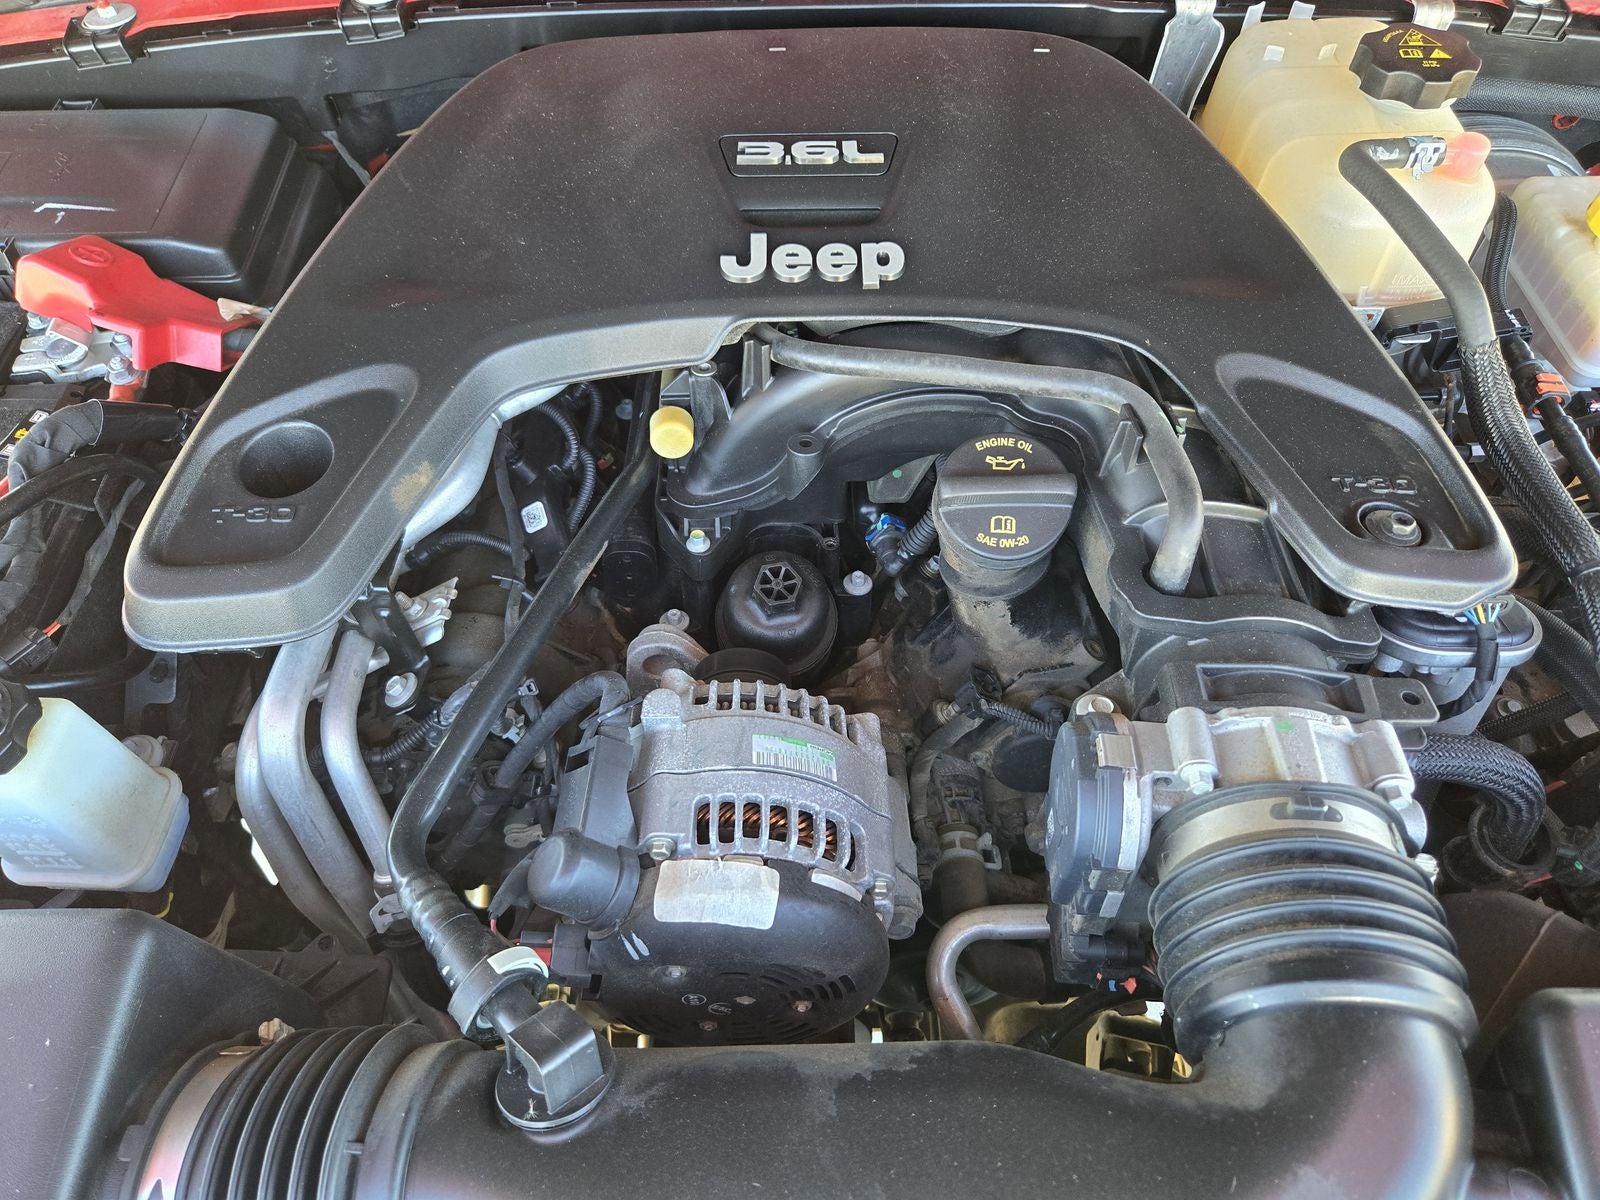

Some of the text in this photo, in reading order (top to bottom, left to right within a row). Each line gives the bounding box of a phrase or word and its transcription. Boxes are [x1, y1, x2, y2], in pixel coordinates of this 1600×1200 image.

[736, 140, 885, 165] 3.6L
[719, 232, 905, 290] Jeep
[975, 437, 1033, 454] ENGINE OIL
[211, 506, 296, 523] T-30
[976, 532, 1030, 548] SAE 0W-20
